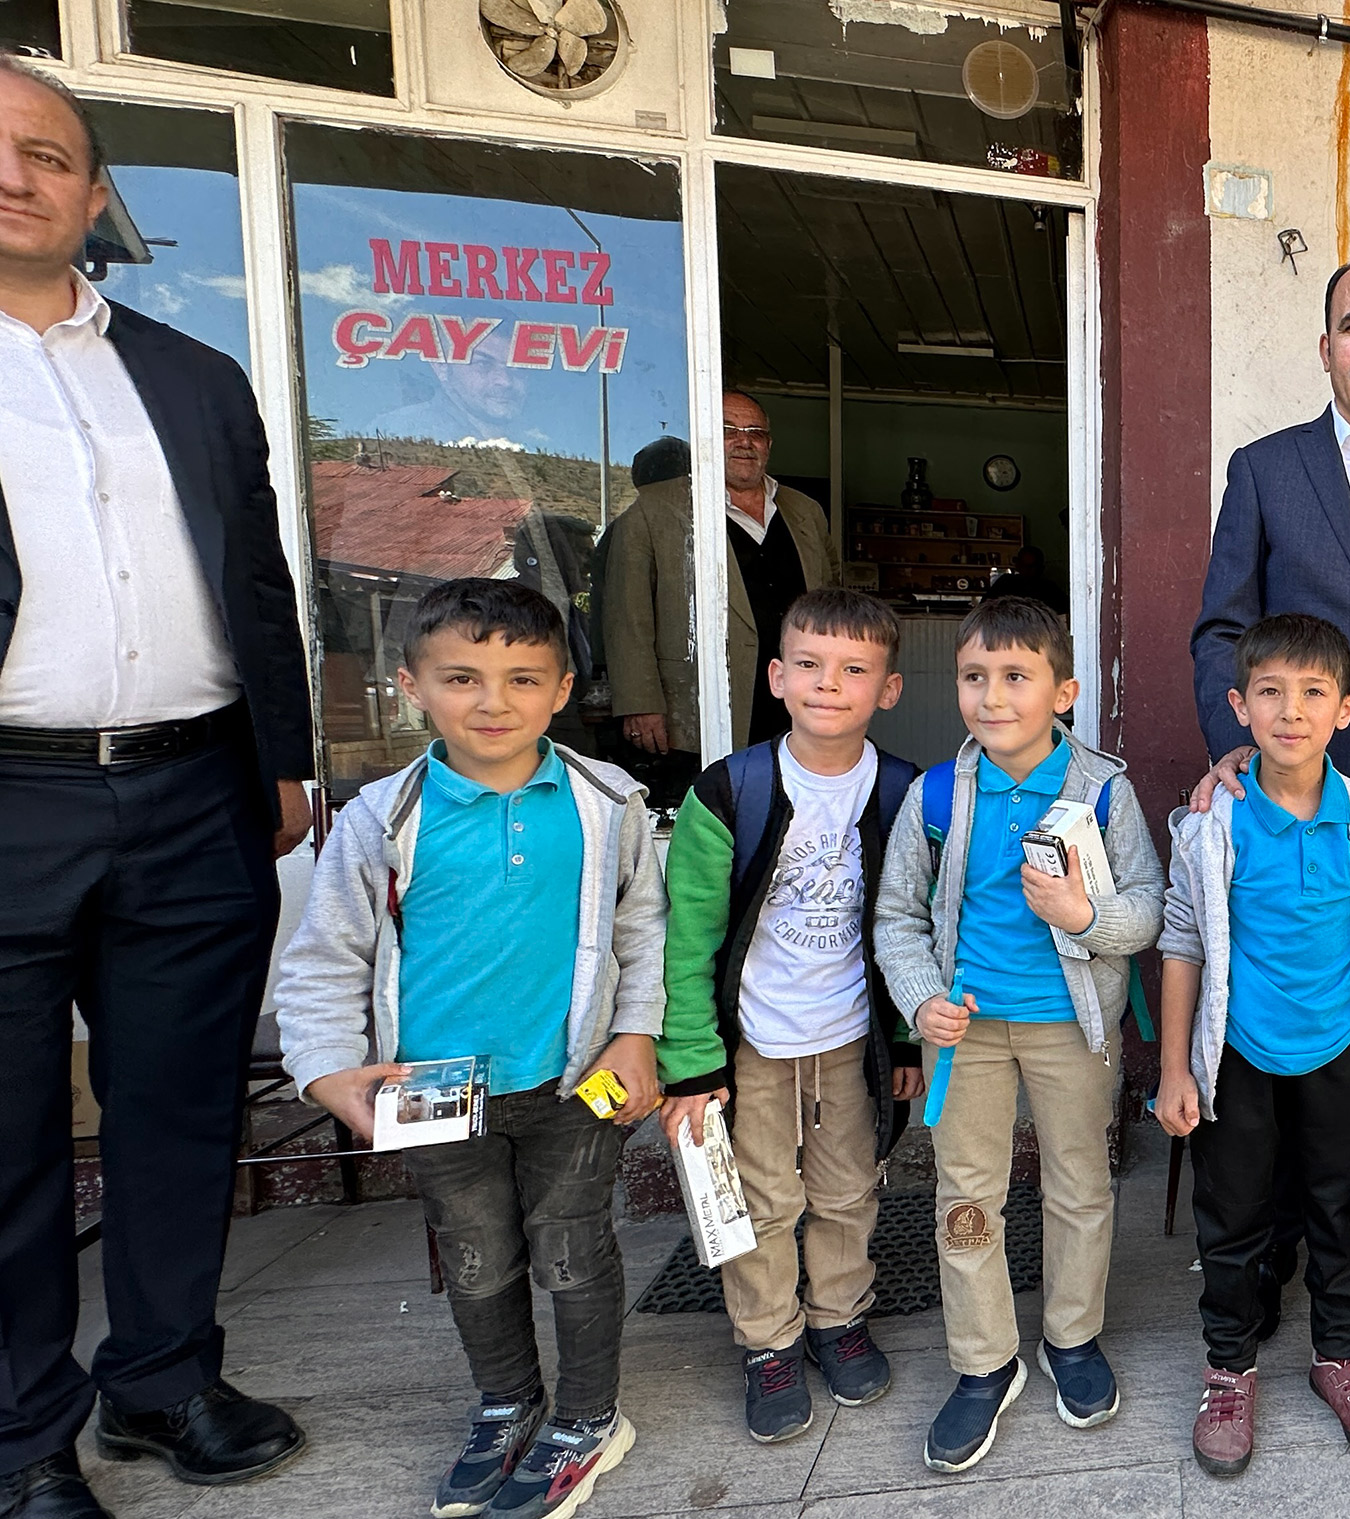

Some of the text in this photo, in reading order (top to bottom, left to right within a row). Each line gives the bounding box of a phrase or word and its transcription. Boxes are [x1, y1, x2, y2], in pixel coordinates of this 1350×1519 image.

[369, 238, 613, 306] MERKEZ
[332, 308, 503, 369] ÇAY
[785, 840, 817, 863] LOS
[774, 919, 860, 949] CALIFORNIA
[700, 1192, 722, 1257] MAX METAL
